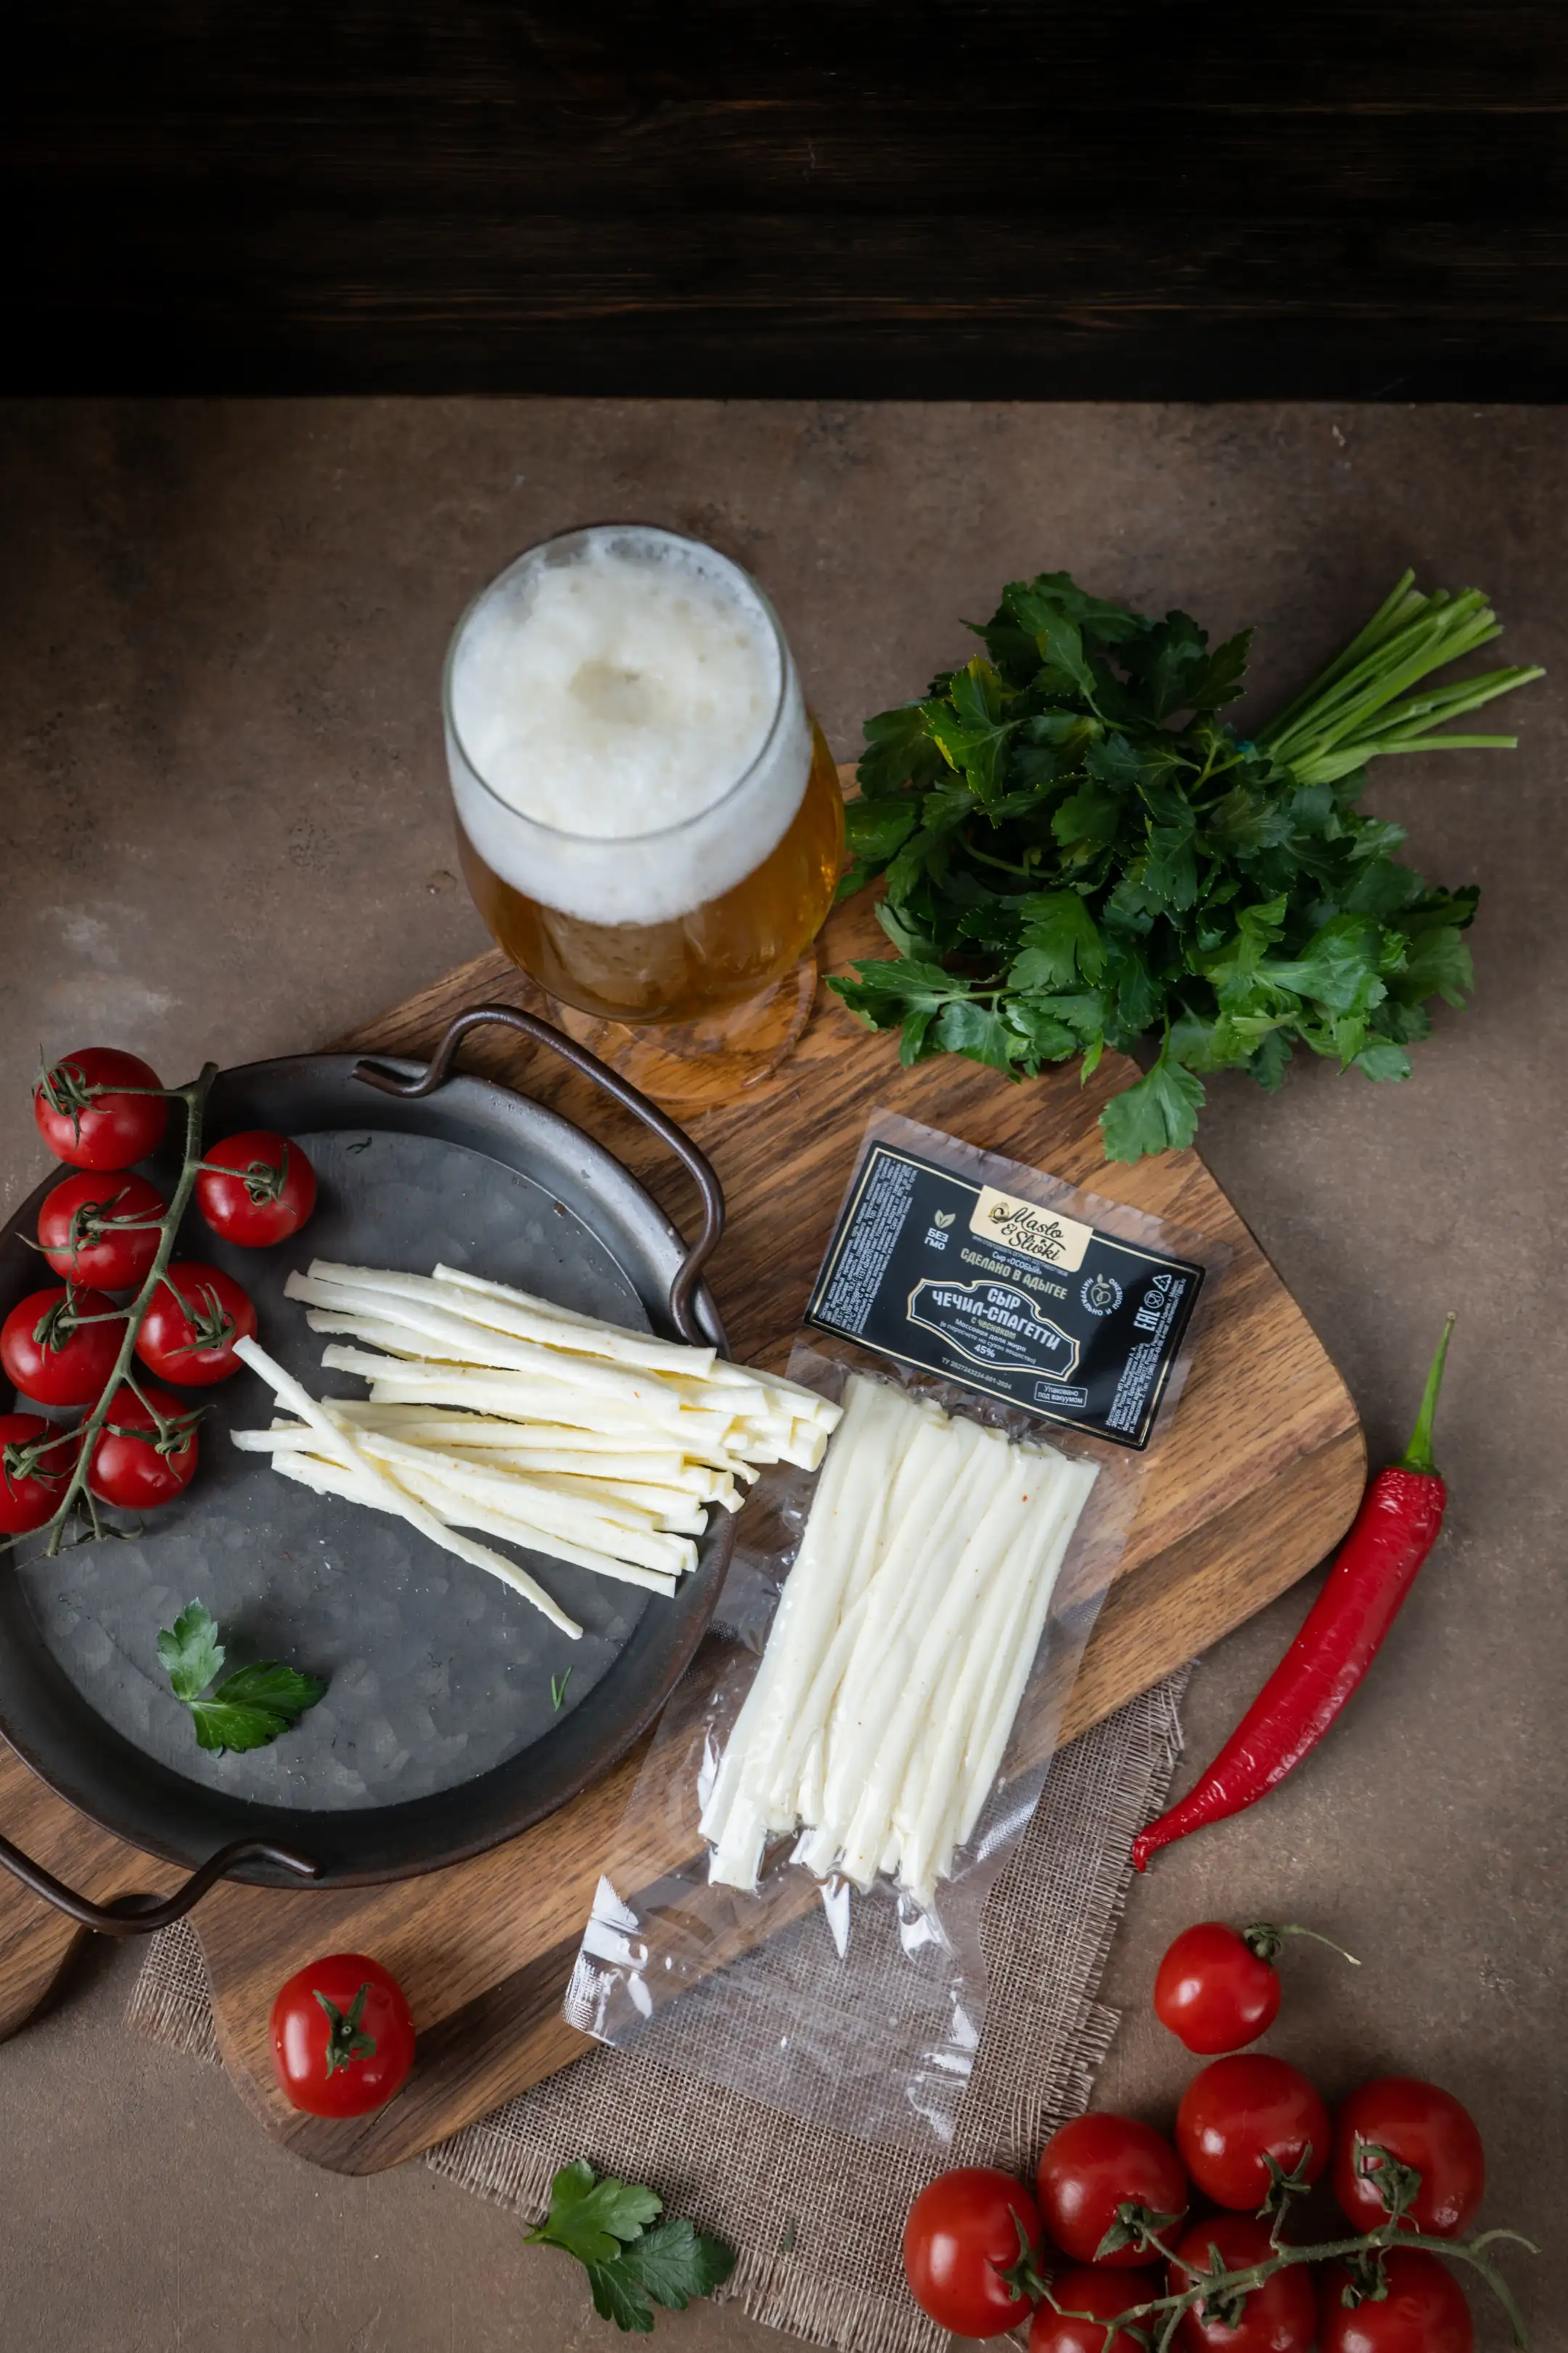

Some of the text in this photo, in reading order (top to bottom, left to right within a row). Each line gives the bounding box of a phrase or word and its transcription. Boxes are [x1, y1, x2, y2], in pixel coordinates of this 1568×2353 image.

[1004, 1207, 1064, 1239] Maslo
[924, 1236, 945, 1251] ГМО
[927, 1227, 949, 1243] БЕЗ
[992, 1251, 1006, 1263] Сыр
[1006, 1258, 1043, 1275] «ОСОБЫЙ»
[960, 1248, 1011, 1277] СДЕЛАНО
[1012, 1269, 1022, 1281] В
[1022, 1274, 1069, 1300] АДЫГЕЕ
[987, 1288, 1021, 1309] СЫР
[1080, 1277, 1103, 1316] НАТУРАЛЬНО
[1108, 1278, 1123, 1309] ПОЛЕЗНО
[932, 1290, 1061, 1351] ЧЕЧИЛ-СПАГЕТТИ
[977, 1319, 1017, 1340] чесноком
[955, 1318, 1027, 1352] Массовая доля жира
[974, 1343, 996, 1359] 45%
[1038, 1391, 1083, 1405] под вакуумом
[1043, 1384, 1079, 1397] Упаковано
